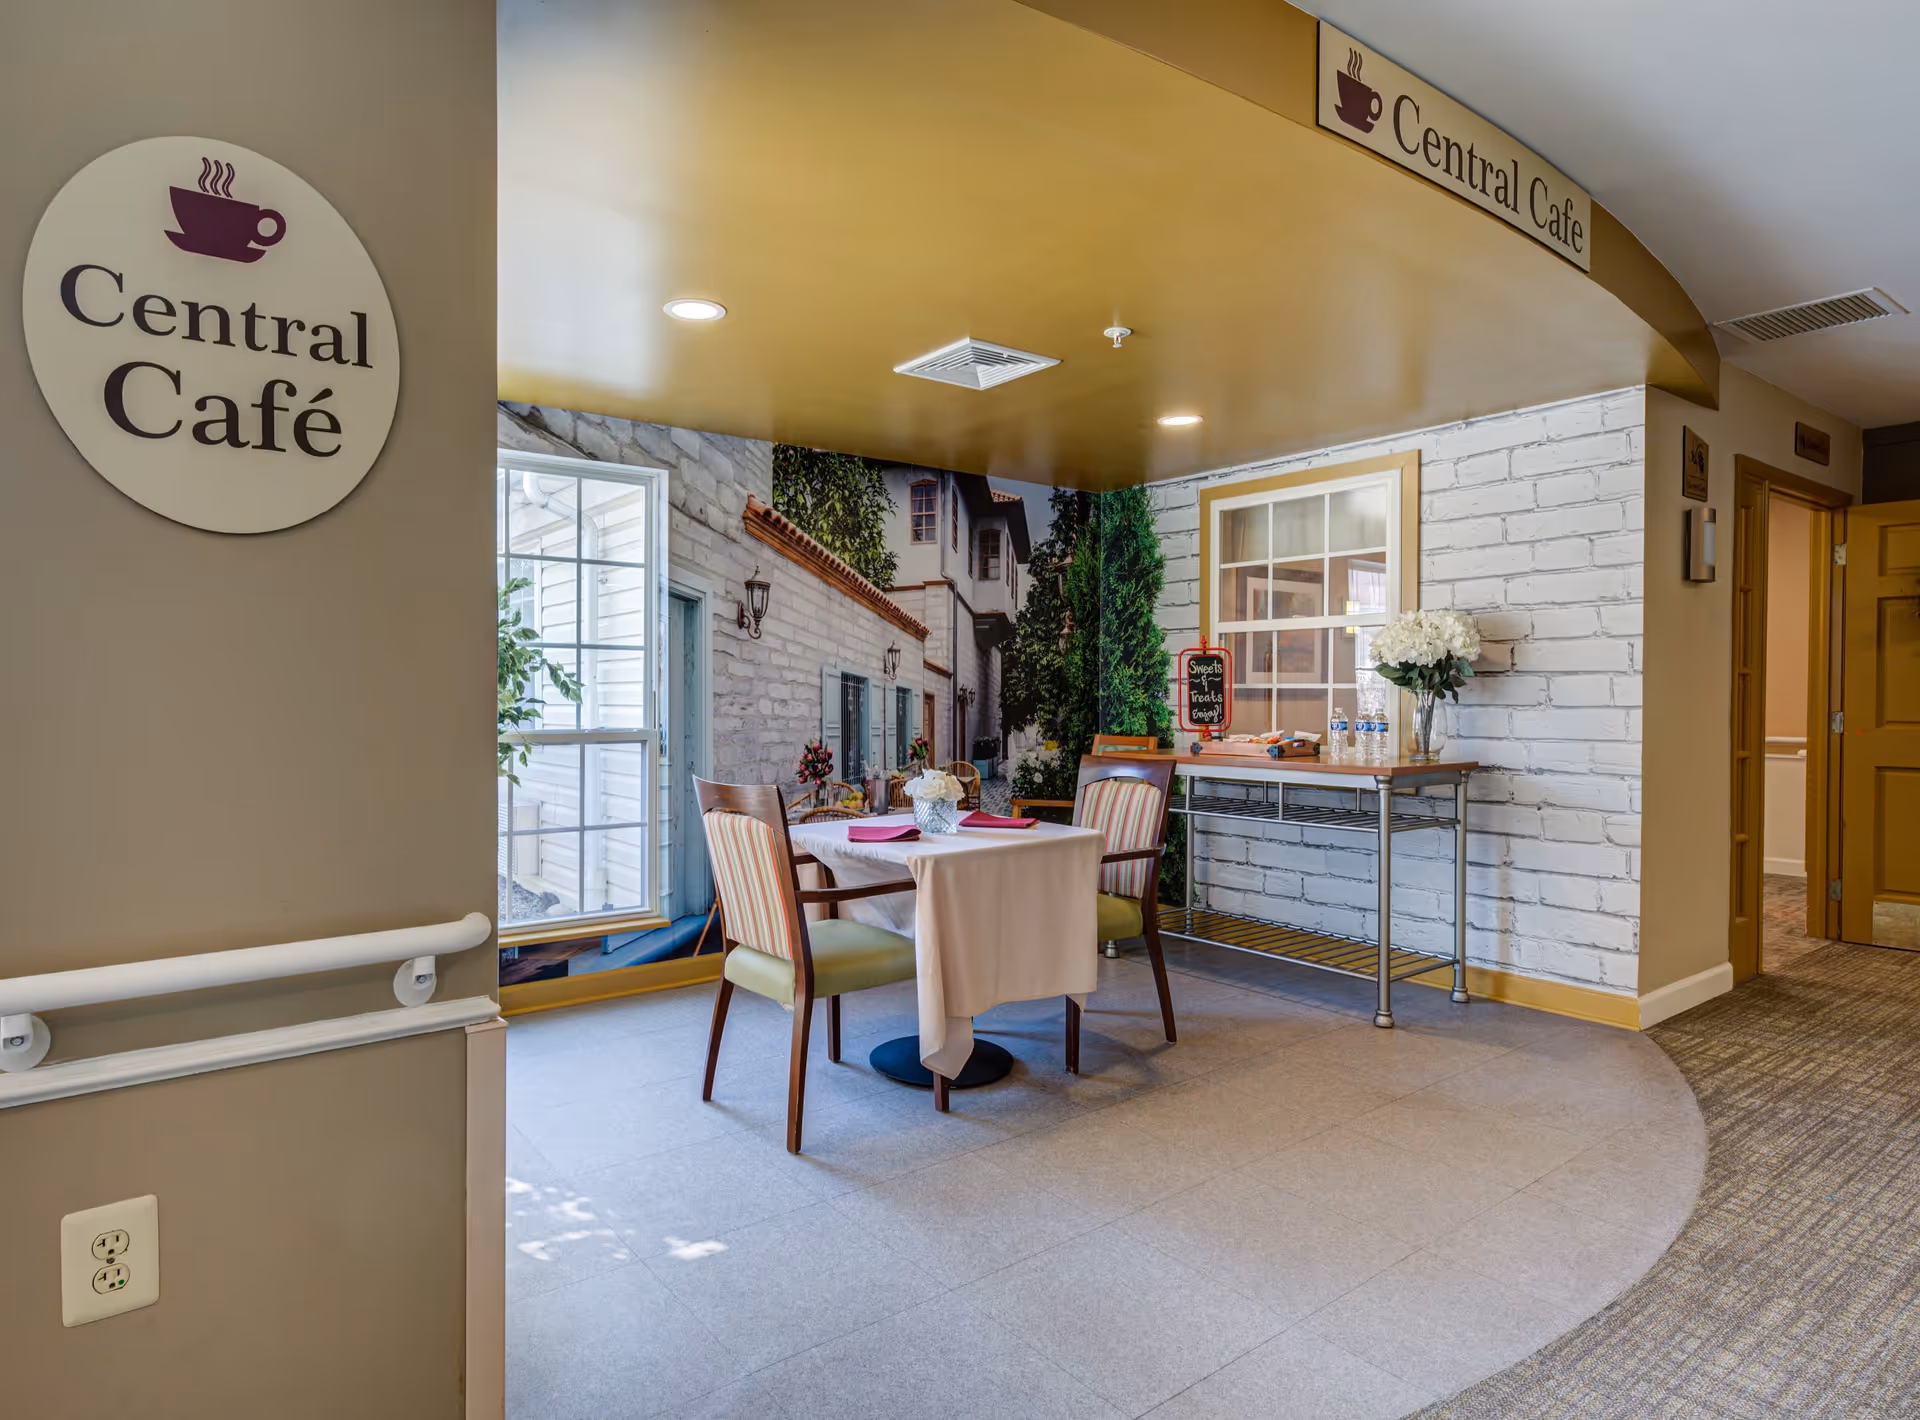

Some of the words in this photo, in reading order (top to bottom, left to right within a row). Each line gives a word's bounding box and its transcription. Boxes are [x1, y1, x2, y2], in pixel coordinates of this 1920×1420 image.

[1393, 94, 1520, 215] Central
[1529, 176, 1583, 254] Cafe
[60, 264, 373, 369] Central
[103, 361, 342, 458] Café
[1189, 660, 1223, 674] Sweets
[1190, 690, 1223, 703] Treats
